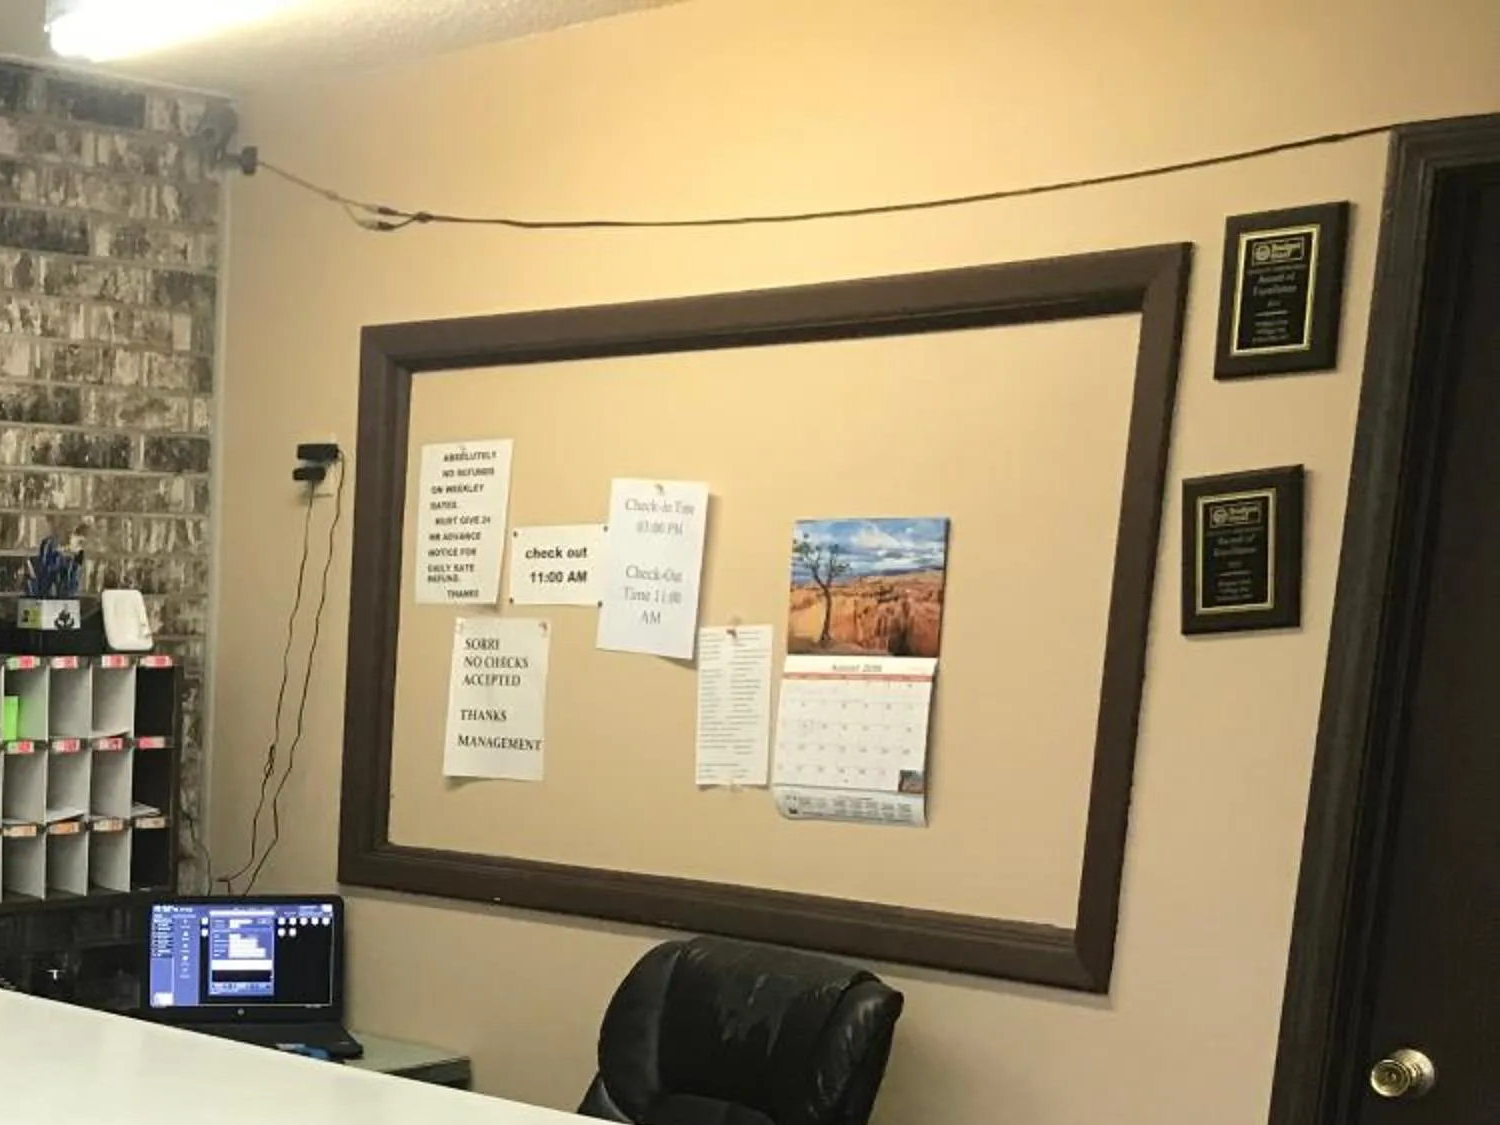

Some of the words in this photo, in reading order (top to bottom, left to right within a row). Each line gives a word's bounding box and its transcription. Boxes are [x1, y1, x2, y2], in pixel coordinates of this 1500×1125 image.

[525, 546, 563, 560] check
[567, 546, 588, 560] out
[529, 570, 564, 584] 11:00
[567, 570, 588, 584] AM
[639, 608, 661, 625] AM
[464, 655, 483, 668] NO
[484, 656, 529, 669] CHECKS
[462, 673, 521, 687] ACCEPTED
[460, 708, 507, 722] THANKS
[457, 733, 543, 752] MANAGEMENT
